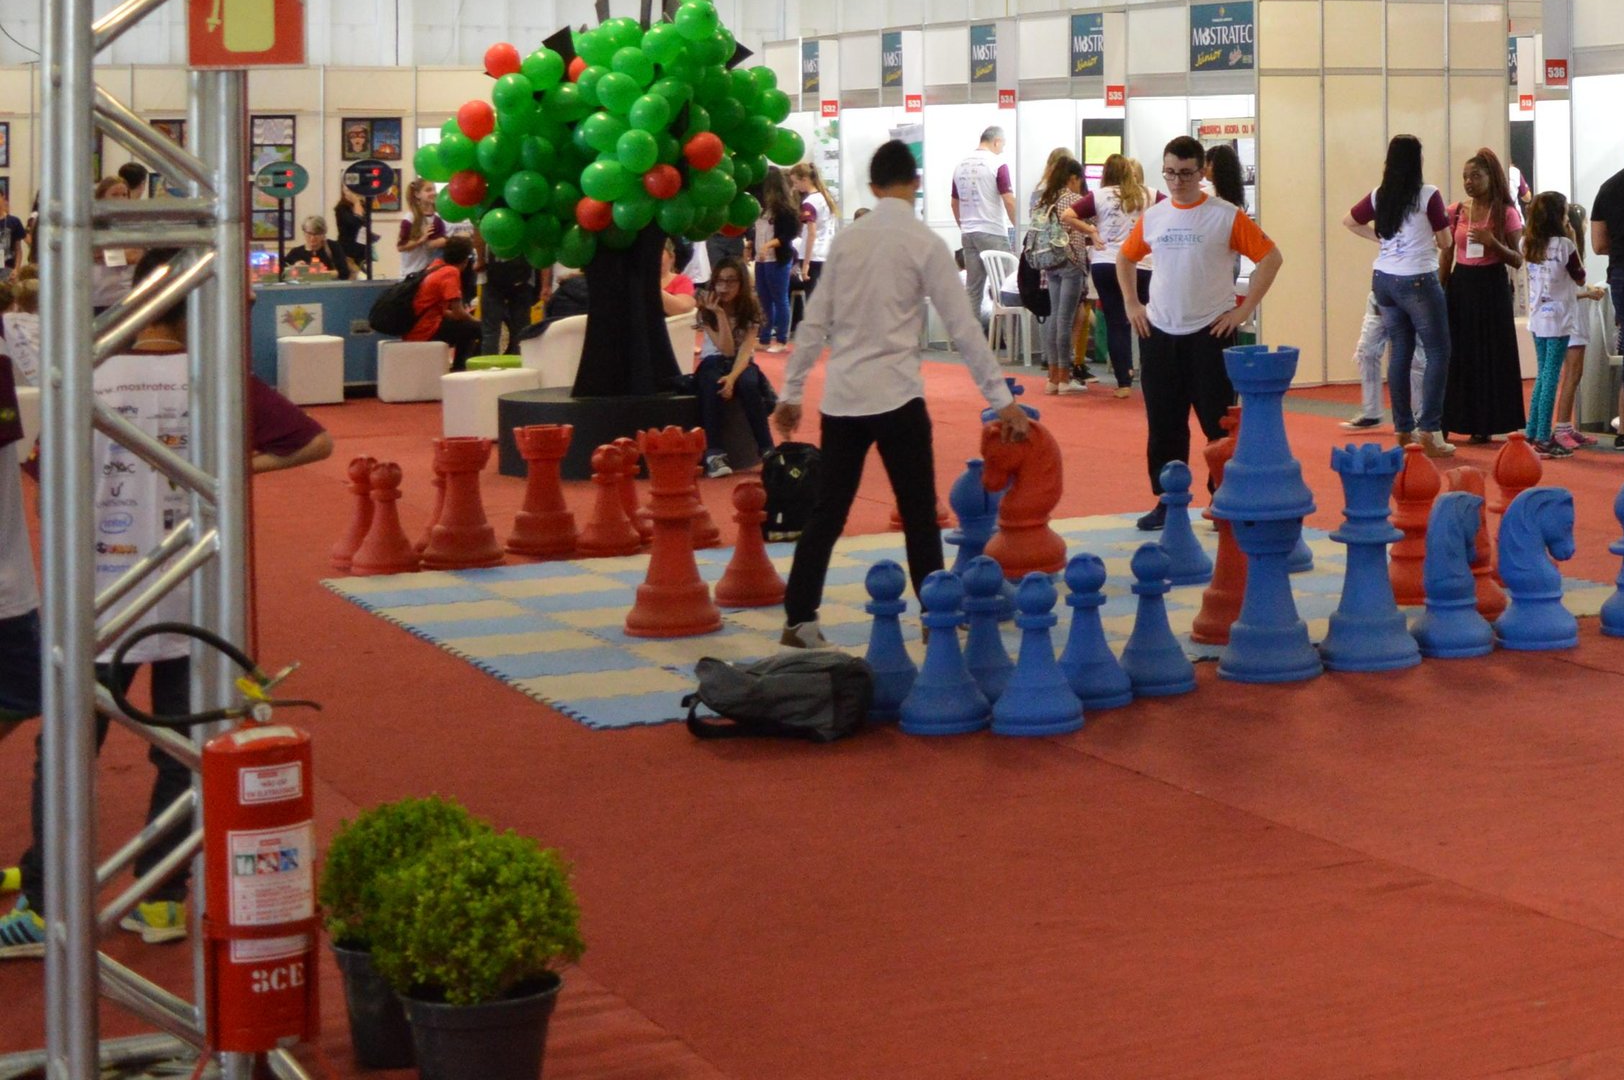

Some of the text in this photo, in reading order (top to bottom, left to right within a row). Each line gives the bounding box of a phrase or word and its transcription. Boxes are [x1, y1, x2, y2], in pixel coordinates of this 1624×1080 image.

[1073, 34, 1104, 54] MOSTR
[1192, 23, 1253, 47] MOSTRATEC
[1547, 66, 1566, 78] 536
